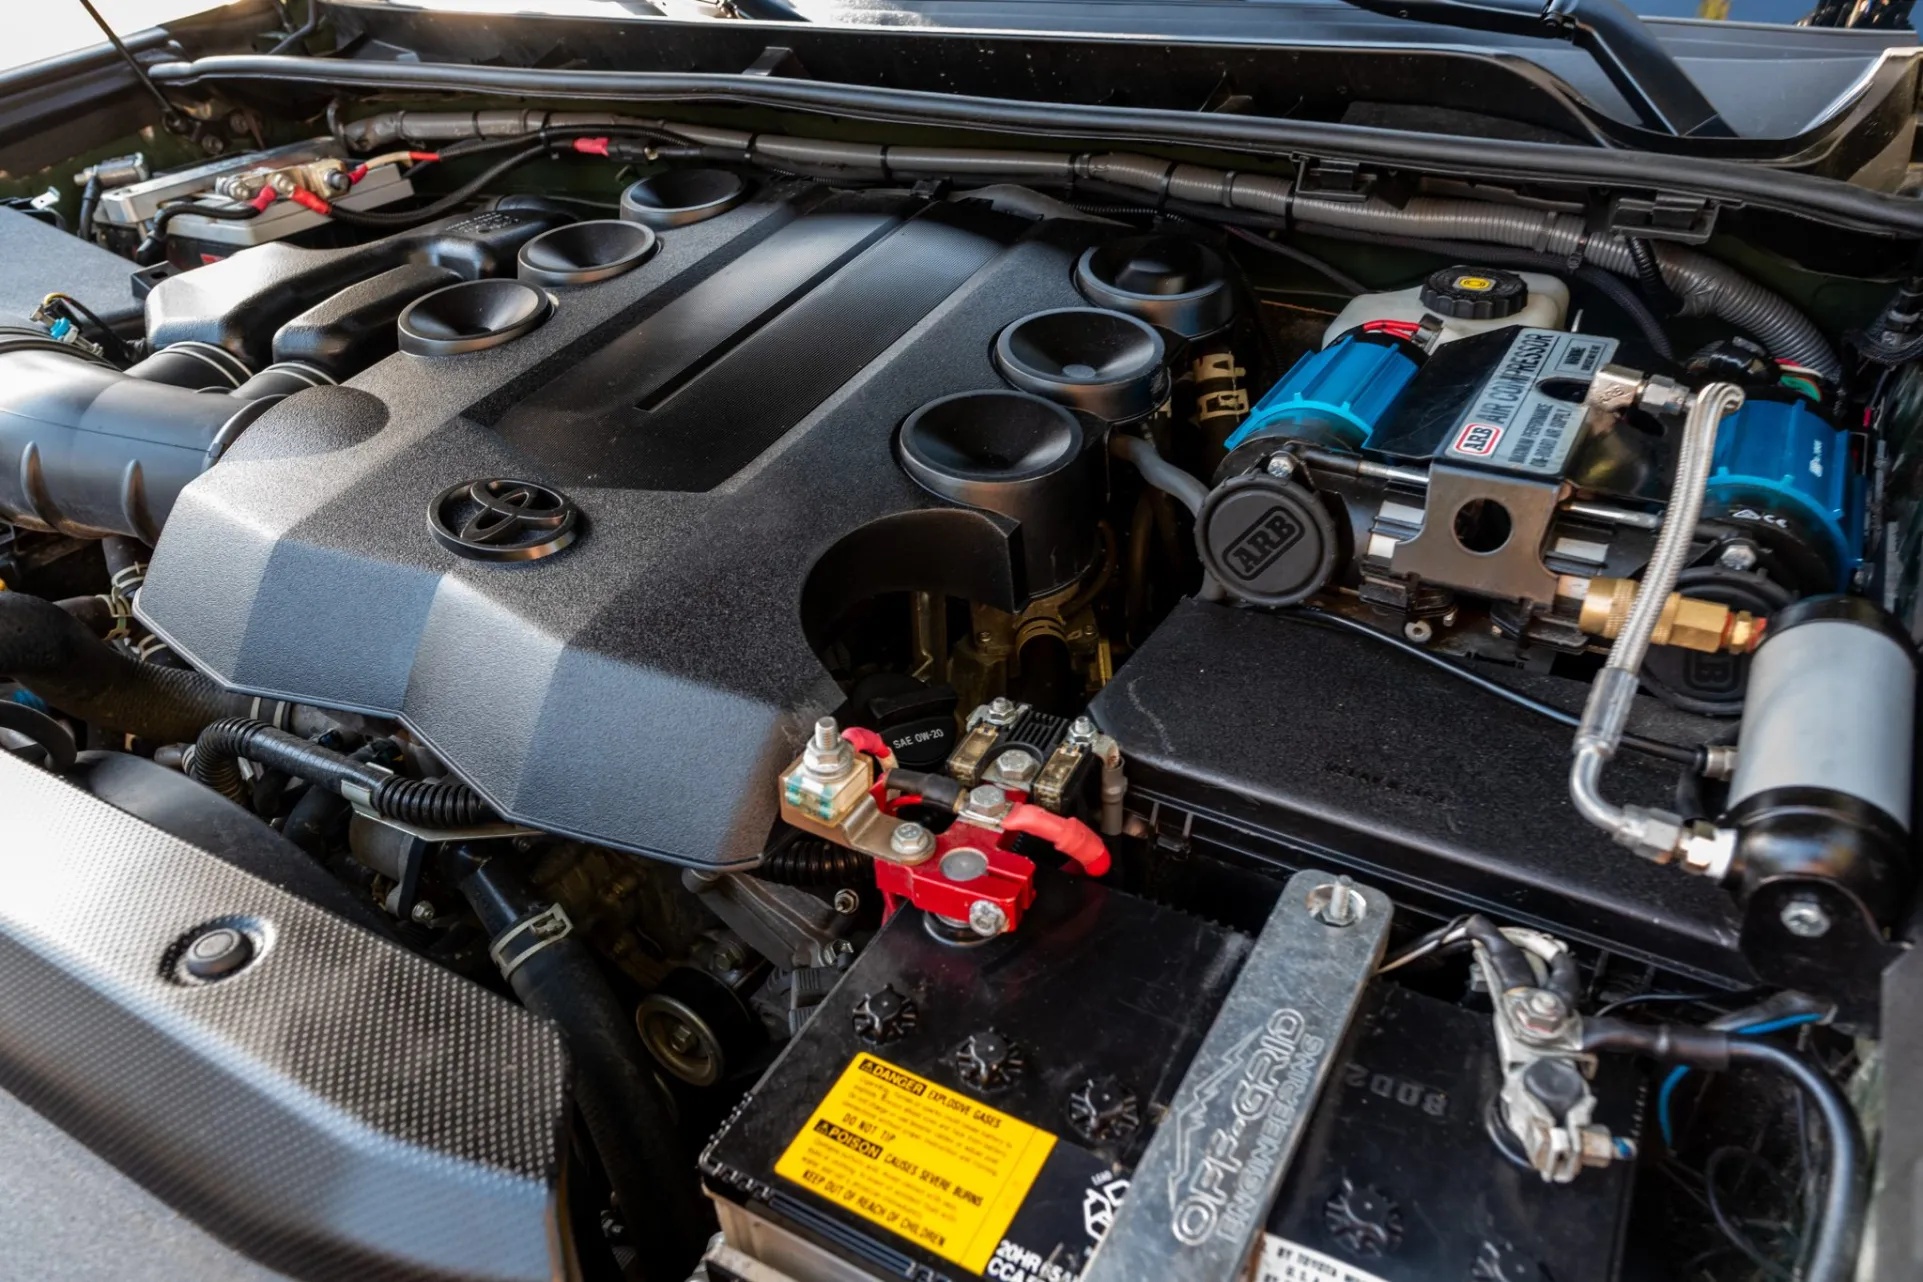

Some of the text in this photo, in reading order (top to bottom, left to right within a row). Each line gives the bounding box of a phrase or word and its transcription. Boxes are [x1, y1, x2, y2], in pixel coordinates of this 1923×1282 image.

[1475, 333, 1554, 425] AIR COMPRESSOR
[1463, 426, 1493, 451] ARB
[1231, 515, 1297, 574] ARB
[892, 728, 945, 749] SAE 0W-20
[842, 1112, 896, 1142] DO NOT TIP
[872, 1064, 1002, 1129] DANGER EXPLOSIVE GASES
[1171, 1007, 1306, 1247] OFF-GRID
[828, 1125, 984, 1207] POISON CAUSES SEVERE BURNS
[1216, 1032, 1325, 1246] ENGINEERING
[802, 1169, 946, 1247] KEEP OUT OF REACH OF CHILDREN
[995, 1239, 1043, 1274] 20HR
